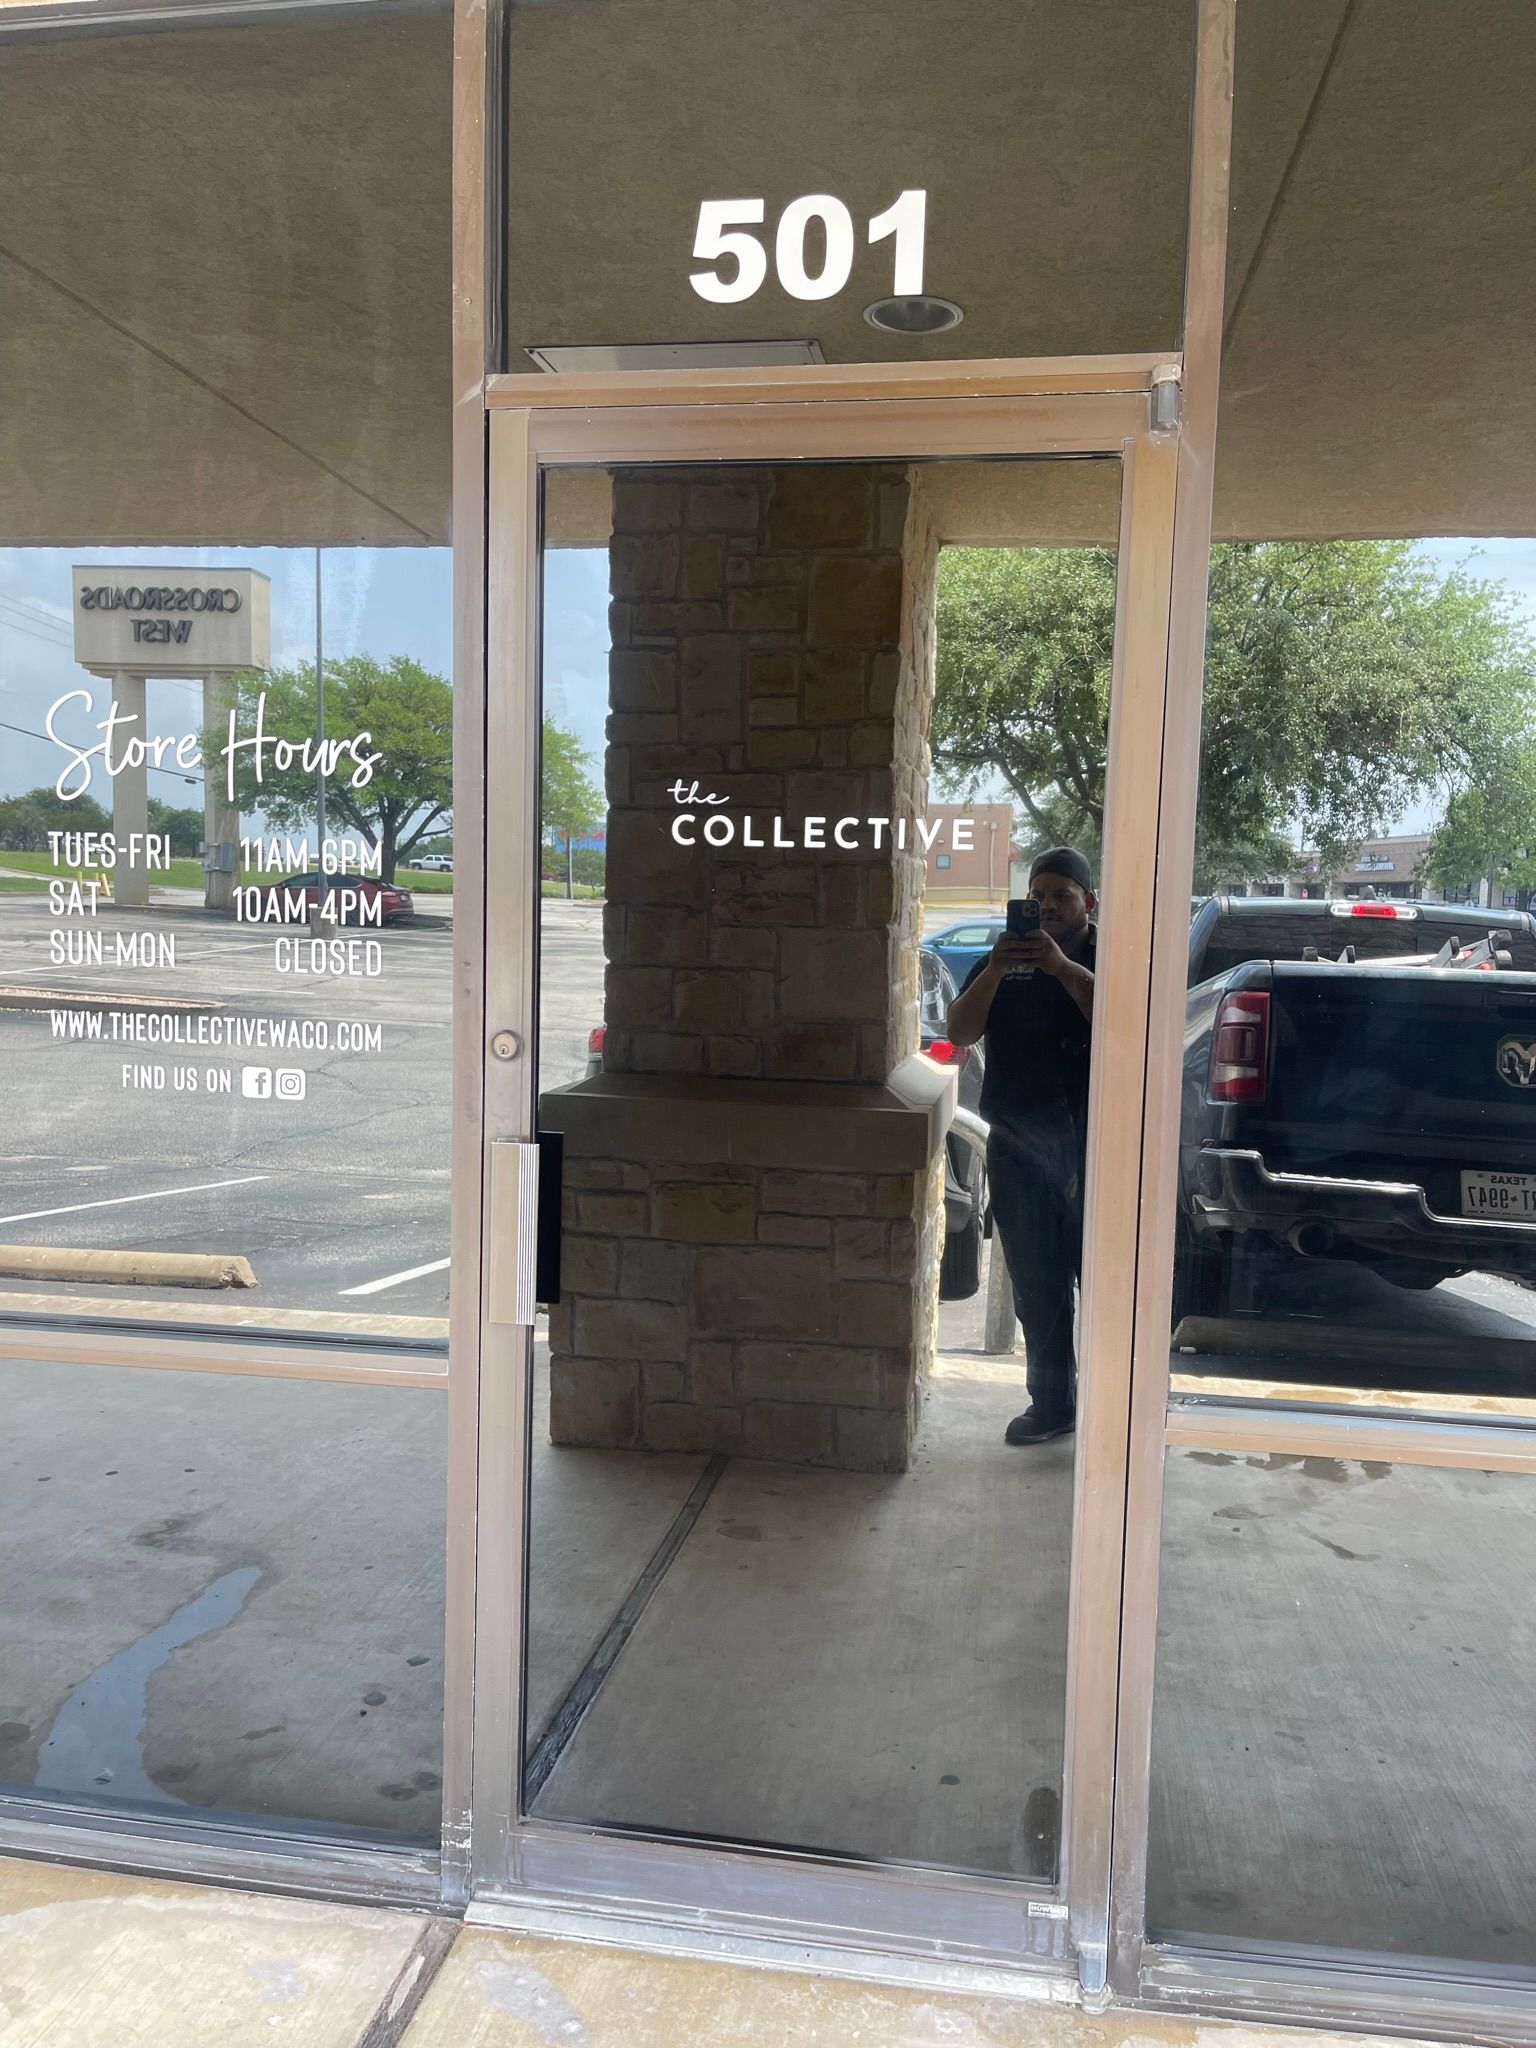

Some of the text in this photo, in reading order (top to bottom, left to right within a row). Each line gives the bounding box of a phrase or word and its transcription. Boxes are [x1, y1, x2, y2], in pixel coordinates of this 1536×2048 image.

[689, 190, 927, 304] 501
[45, 690, 383, 802] Store Hours
[667, 778, 730, 804] the
[48, 831, 382, 876] TUES-FRI 11AM-6PM
[671, 814, 975, 852] COLLECTIVE
[49, 880, 382, 927] SAT 10AM-4PM
[50, 929, 382, 976] SUN-MON CLOSED
[50, 1010, 382, 1052] WWW.THECOLLECTIVEWACO.COM
[122, 1064, 165, 1090] FIND
[173, 1066, 198, 1091] US
[206, 1068, 231, 1093] ON
